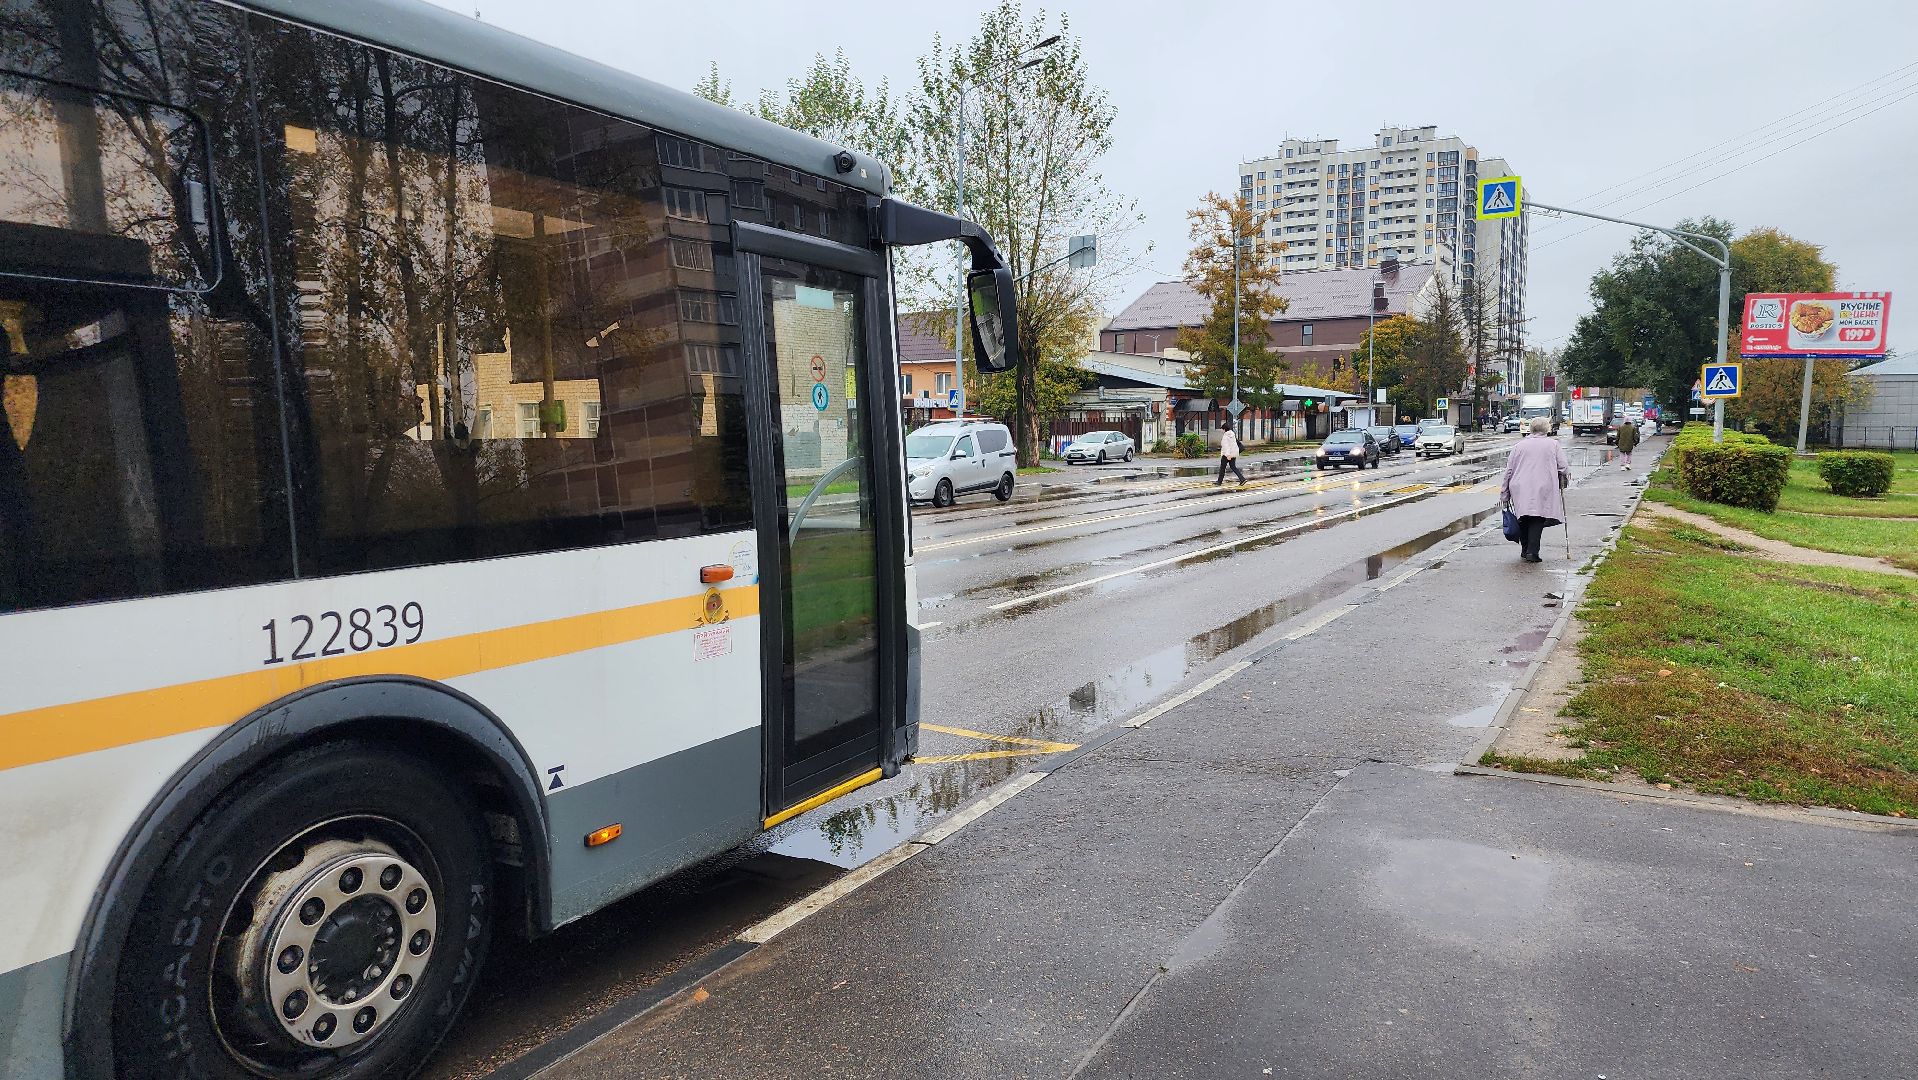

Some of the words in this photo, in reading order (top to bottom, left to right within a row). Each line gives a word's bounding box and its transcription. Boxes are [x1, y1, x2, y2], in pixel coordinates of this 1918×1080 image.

[1840, 302, 1881, 311] ВКУСНЫЕ
[1839, 318, 1852, 326] МОЙ
[262, 600, 424, 665] 122839
